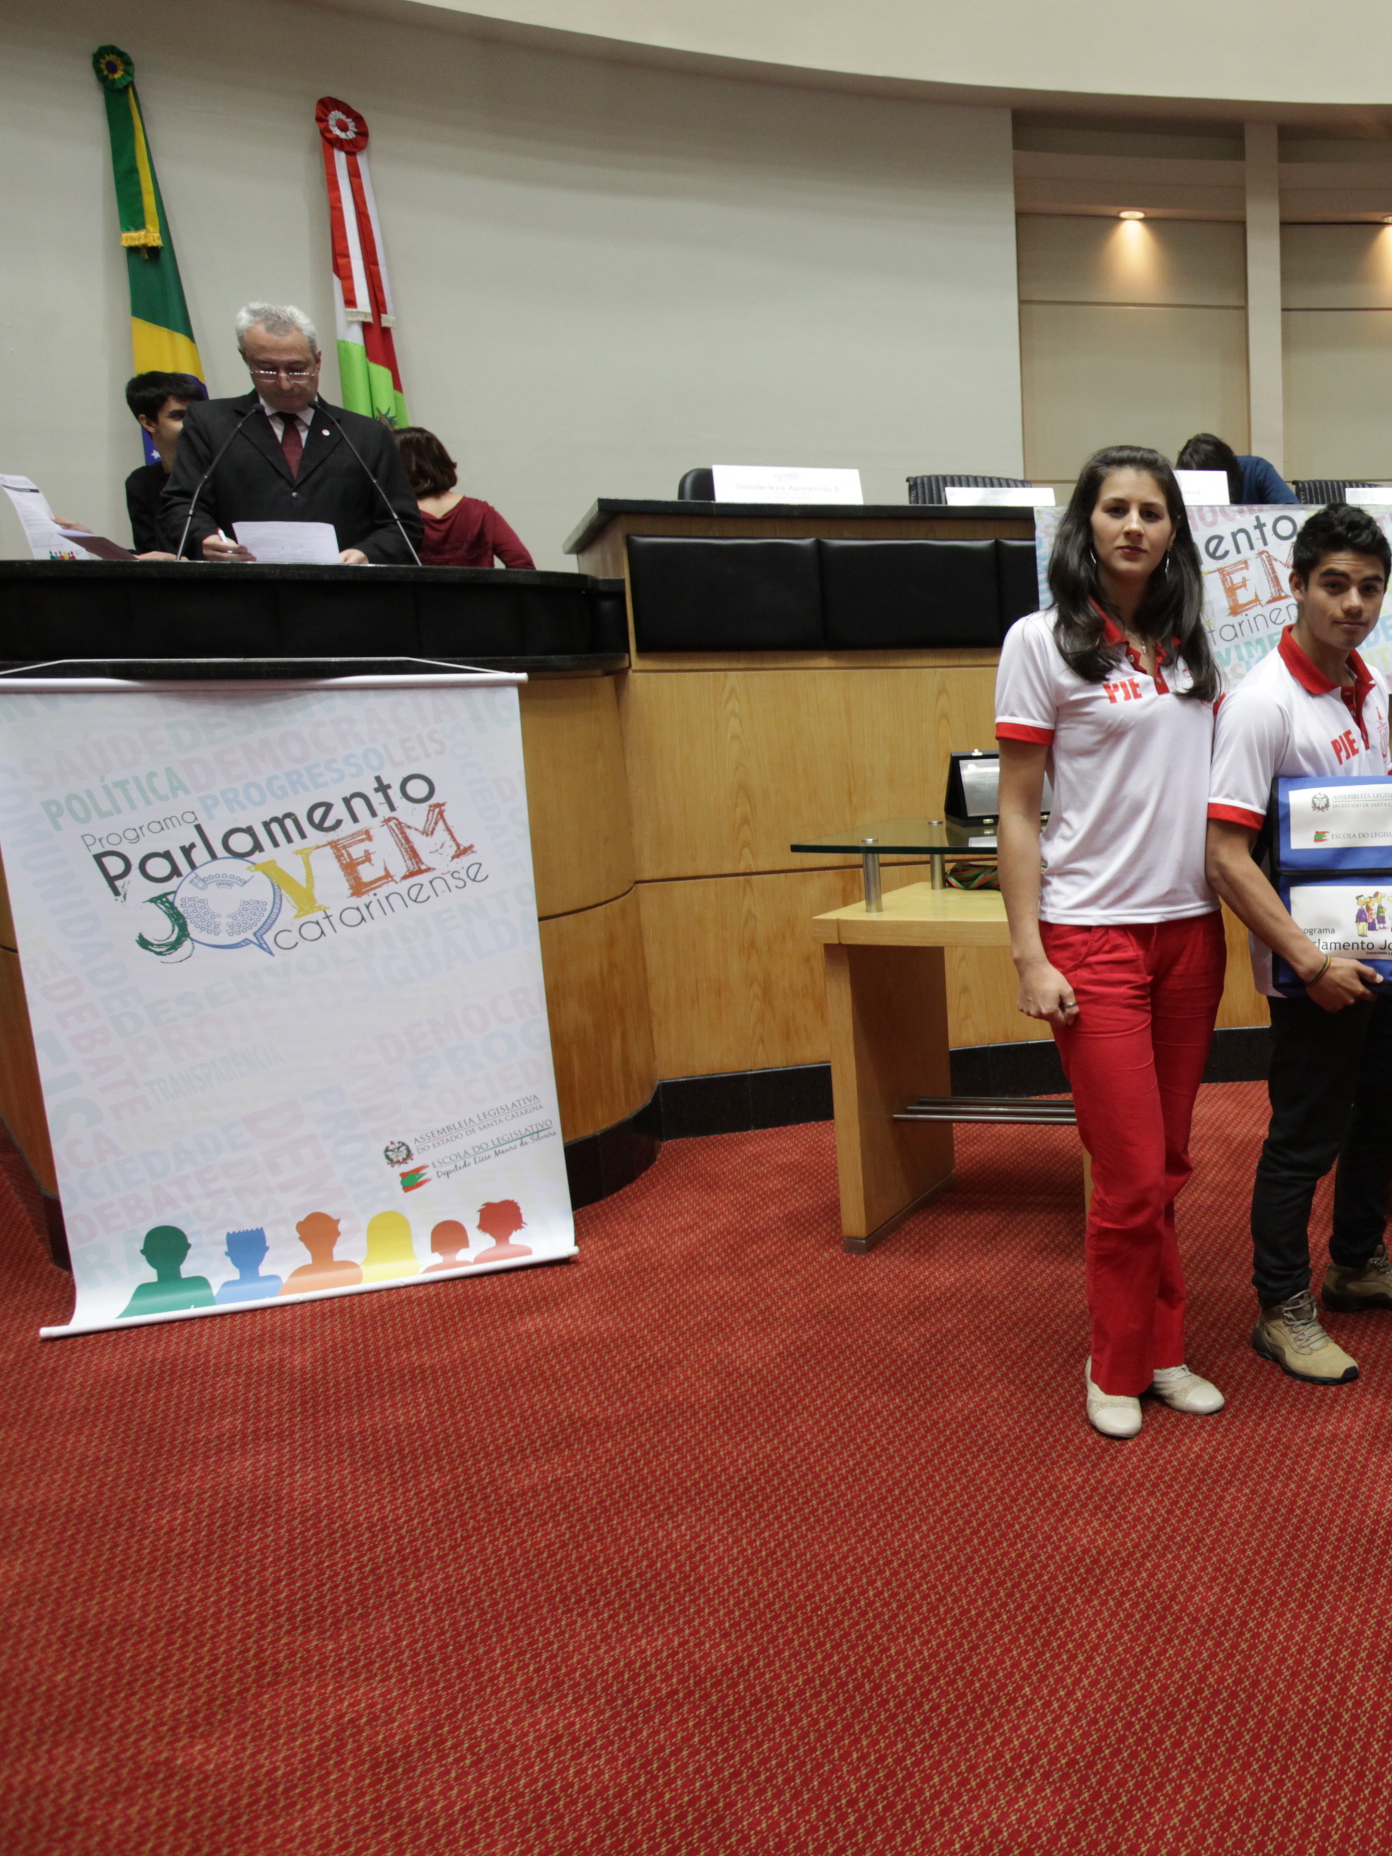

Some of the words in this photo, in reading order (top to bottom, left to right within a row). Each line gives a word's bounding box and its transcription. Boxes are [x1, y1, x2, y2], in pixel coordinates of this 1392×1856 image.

[21, 725, 172, 792] SAÚDE
[180, 690, 459, 793] DEMOCRACIA
[381, 728, 447, 769] LEIS
[1330, 730, 1359, 765] PJE
[40, 765, 192, 832] POLÍTICA
[197, 747, 386, 821] PROGRESSO
[81, 810, 199, 853] Programa
[92, 772, 436, 897] Parlamento
[1331, 832, 1356, 840] ESCOLA
[273, 861, 489, 950] catarinense
[1300, 926, 1336, 936] rograma
[144, 1040, 286, 1105] TRANSPARÊNCIA
[413, 1117, 476, 1146] ASSEMBLEIA
[476, 1094, 540, 1121] LEGISLATIVA
[416, 1146, 431, 1155] DO
[432, 1133, 464, 1150] ESTADO
[465, 1128, 476, 1137] DE
[478, 1119, 504, 1133] SANTA
[504, 1104, 544, 1122] CATARINA
[431, 1150, 470, 1169] ESCOLA
[472, 1142, 489, 1154] DO
[491, 1119, 553, 1147] LEGISLATIVO
[436, 1162, 472, 1179] Deputado
[67, 1165, 225, 1246] DEBATE
